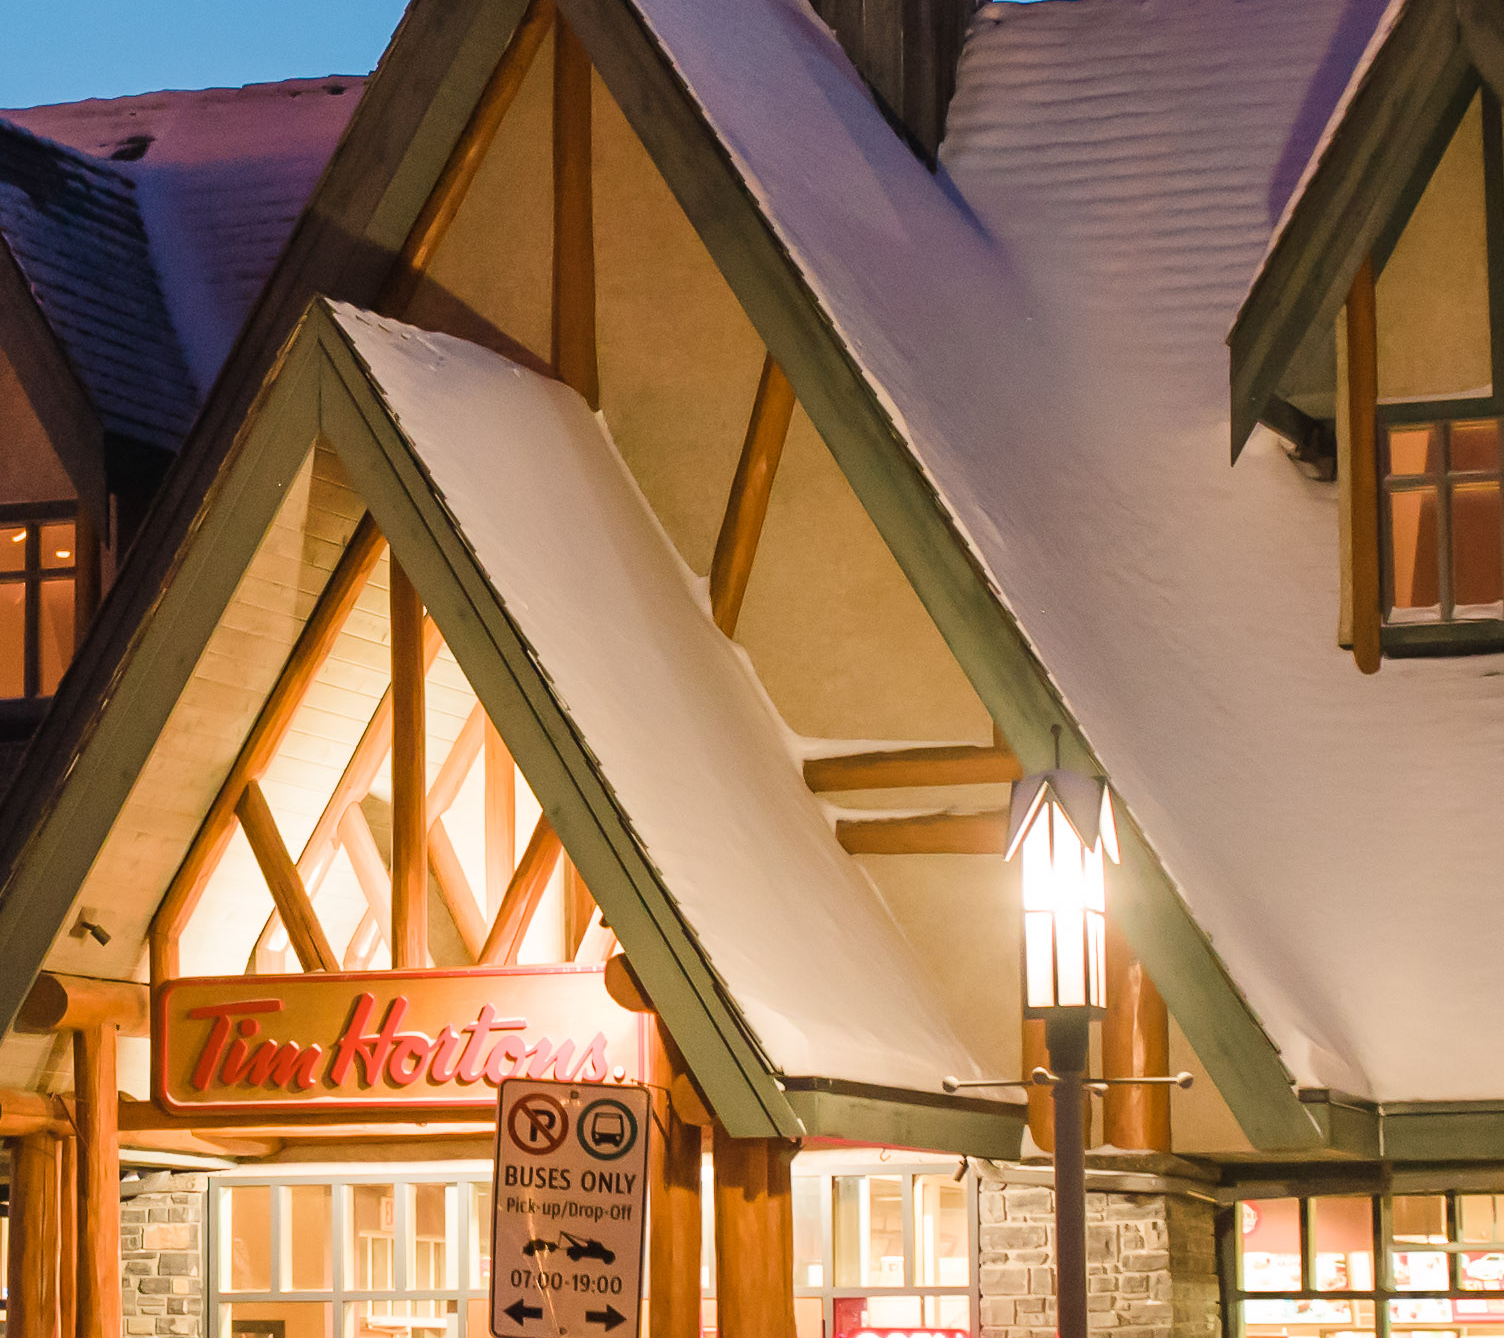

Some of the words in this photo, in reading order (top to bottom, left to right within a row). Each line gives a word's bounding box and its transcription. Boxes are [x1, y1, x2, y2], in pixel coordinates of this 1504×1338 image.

[188, 997, 323, 1091] Tim
[504, 1164, 571, 1191] BUSES
[580, 1170, 637, 1195] ONLY
[506, 1195, 633, 1223] Pick-up/Drop-Off
[510, 1268, 623, 1295] 07:00-19:00
